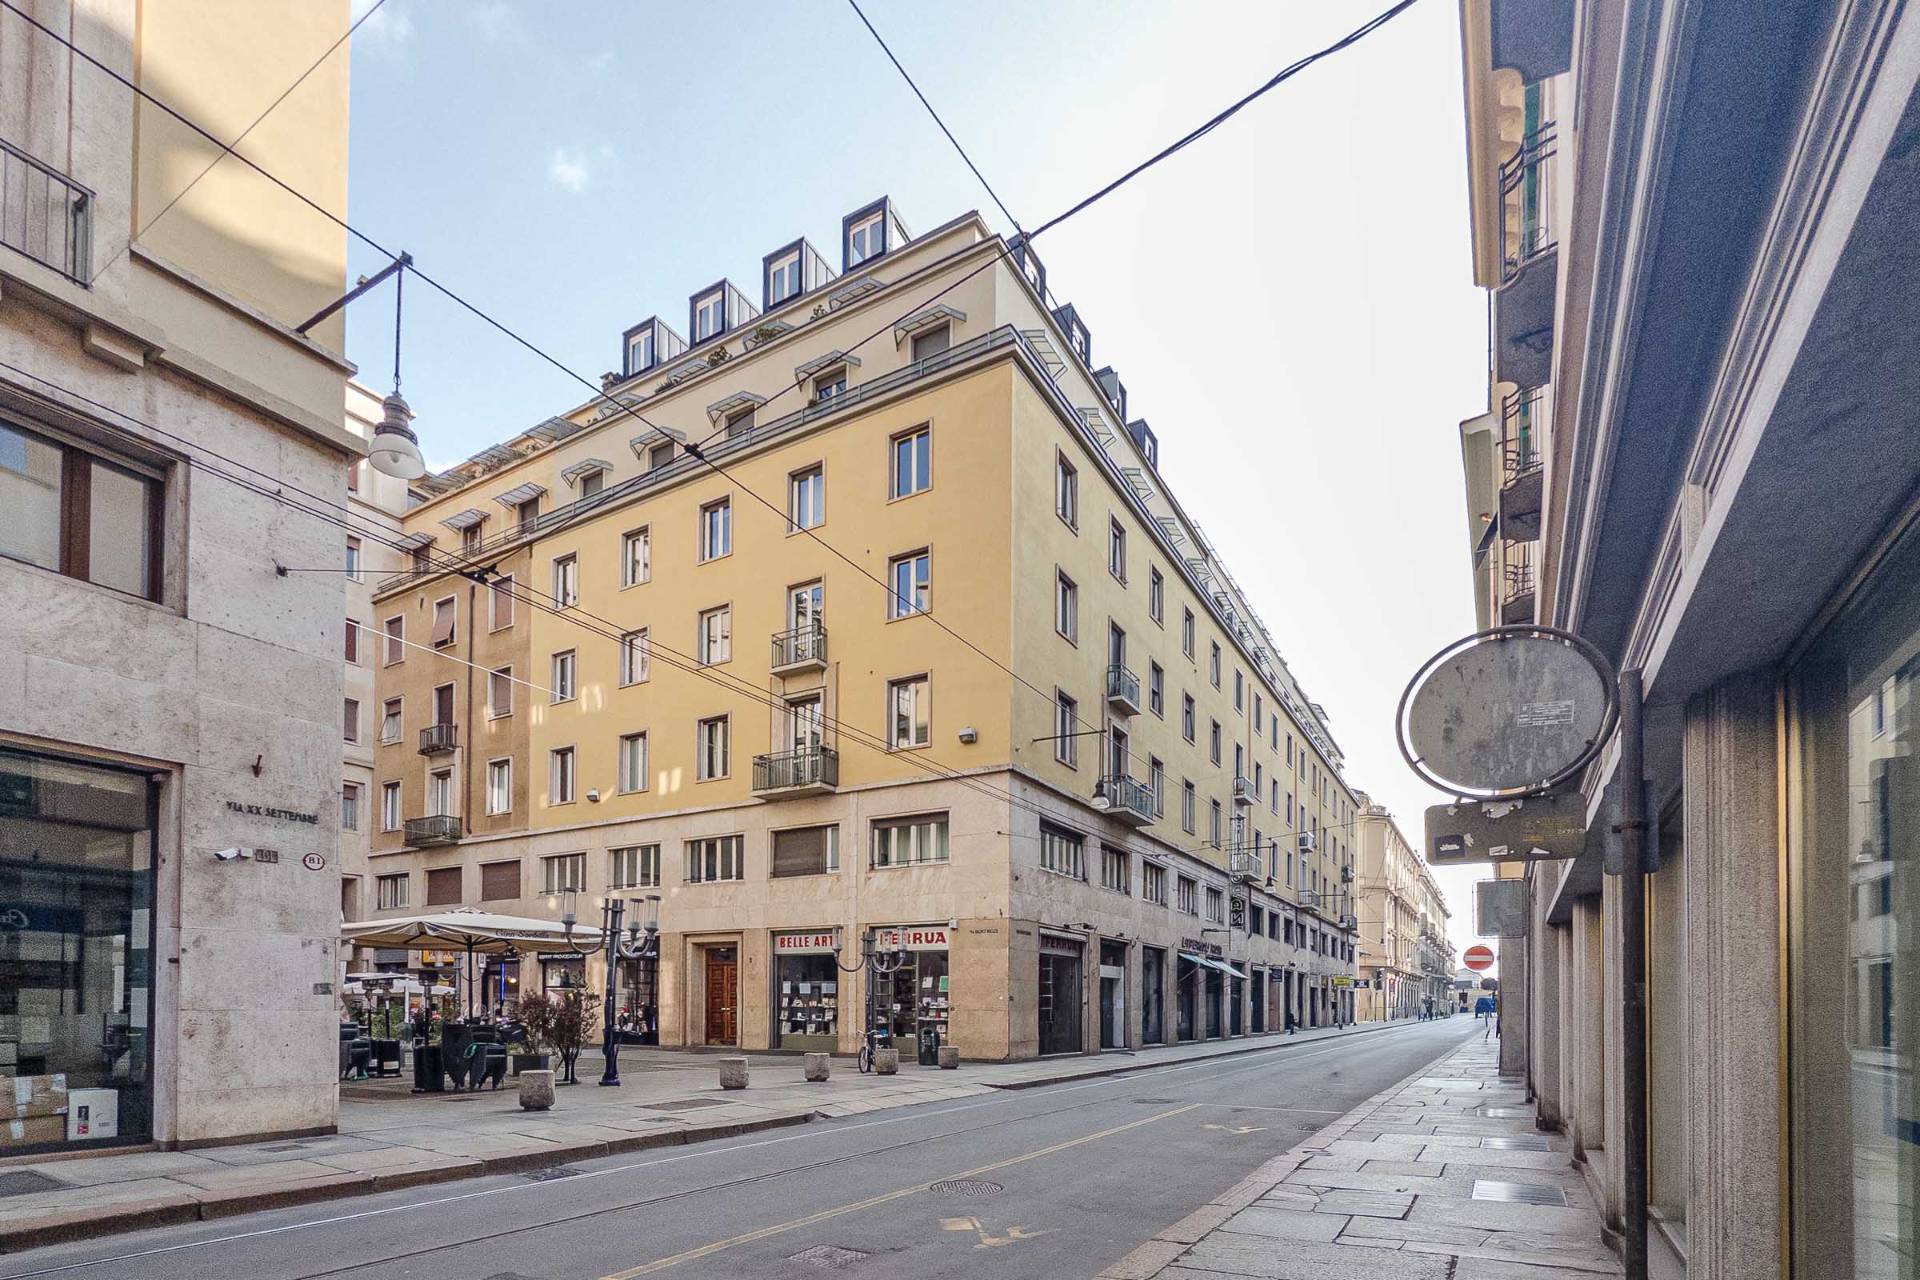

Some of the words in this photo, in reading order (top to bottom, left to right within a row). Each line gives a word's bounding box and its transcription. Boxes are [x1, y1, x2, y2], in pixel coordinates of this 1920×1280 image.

[226, 801, 244, 813] VIA
[247, 805, 262, 816] XX
[265, 808, 319, 824] SETTEMBRE
[780, 937, 810, 948] BELLE
[814, 936, 834, 947] ART
